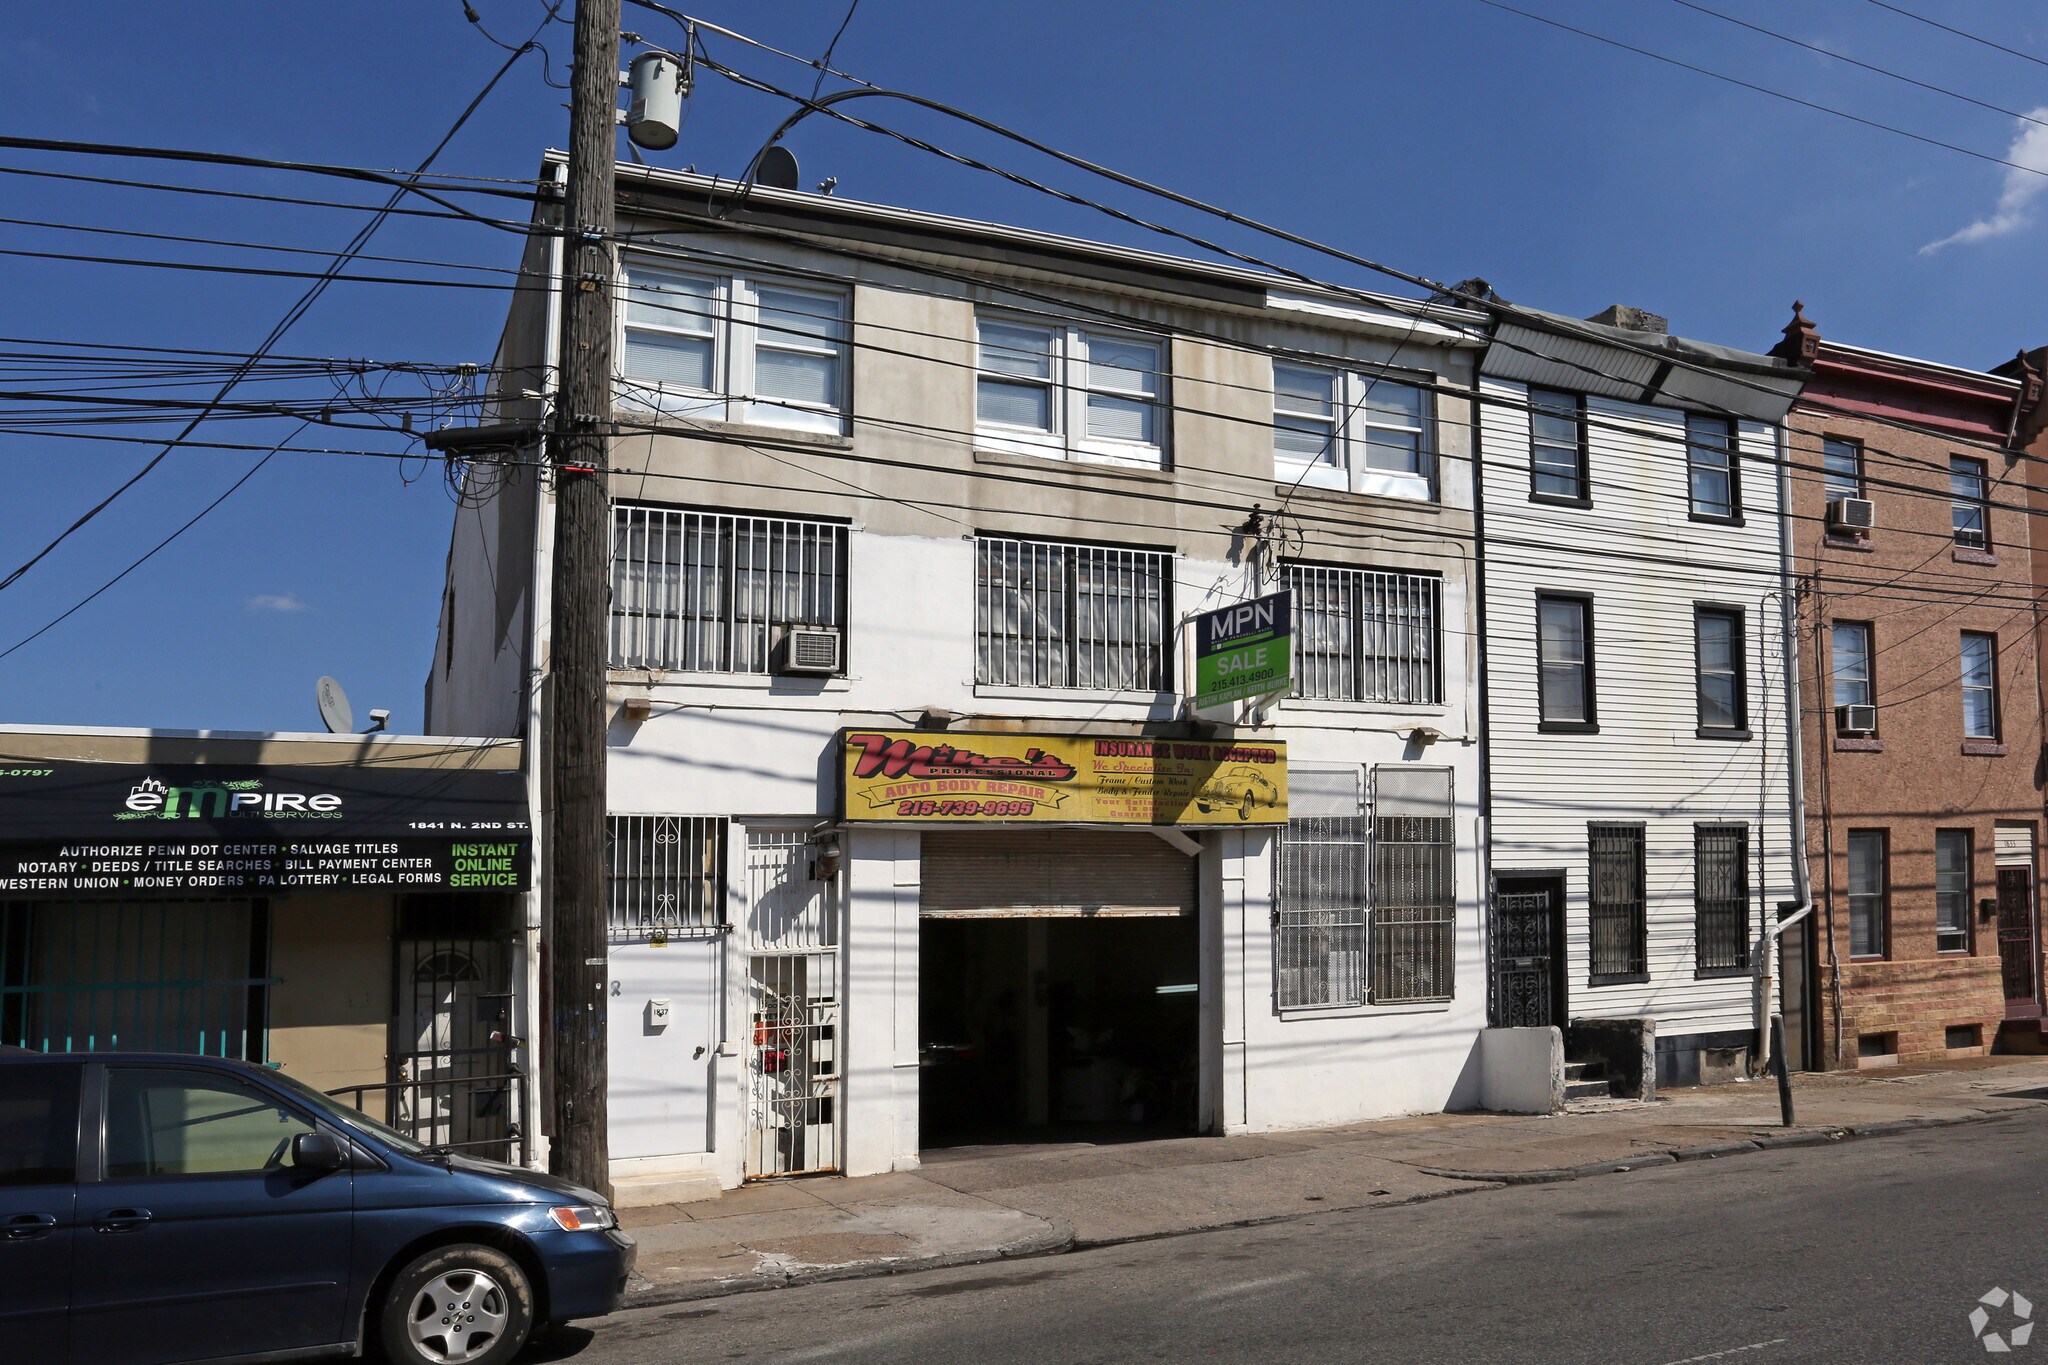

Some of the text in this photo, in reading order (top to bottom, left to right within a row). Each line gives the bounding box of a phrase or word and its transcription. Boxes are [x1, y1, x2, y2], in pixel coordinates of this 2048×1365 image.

[1211, 599, 1274, 640] MPN
[1217, 647, 1268, 676] SALE
[1211, 668, 1274, 692] 215.413.4900
[846, 734, 1077, 781] Mike's
[1094, 740, 1277, 764] INSURANCE WORK ACCEPTED
[929, 768, 1056, 777] PROFESSIONAL
[1092, 760, 1109, 771] We
[1113, 760, 1172, 774] Specialize
[1097, 776, 1126, 786] Frame
[1134, 776, 1164, 786] Custom
[1168, 777, 1189, 786] Work
[885, 779, 1045, 799] AUTO BODY REPAIR
[1096, 787, 1190, 798] Body & Fender Repair
[897, 800, 1035, 816] 215-739-9695
[59, 843, 398, 857] AUTHORIZE PENN DOT CENTER SALVAGE TITLES
[451, 843, 519, 857] INSTANT
[18, 862, 78, 873] NOTARY
[92, 861, 140, 872] DEEDS
[154, 860, 193, 871] TITLE
[198, 860, 272, 871] SEARCHES
[285, 859, 314, 870] BILL
[318, 858, 377, 869] PAYMENT
[382, 858, 432, 869] CENTER
[454, 858, 512, 872] ONLINE
[74, 877, 119, 889] UNION
[134, 876, 183, 888] MONEY
[188, 875, 244, 887] ORDERS
[258, 875, 275, 885] PA
[280, 874, 339, 885] LOTTERY
[352, 873, 394, 884] LEGAL
[398, 873, 442, 883] FORMS
[450, 873, 518, 887] SERVICE
[653, 1008, 669, 1017] 1837
